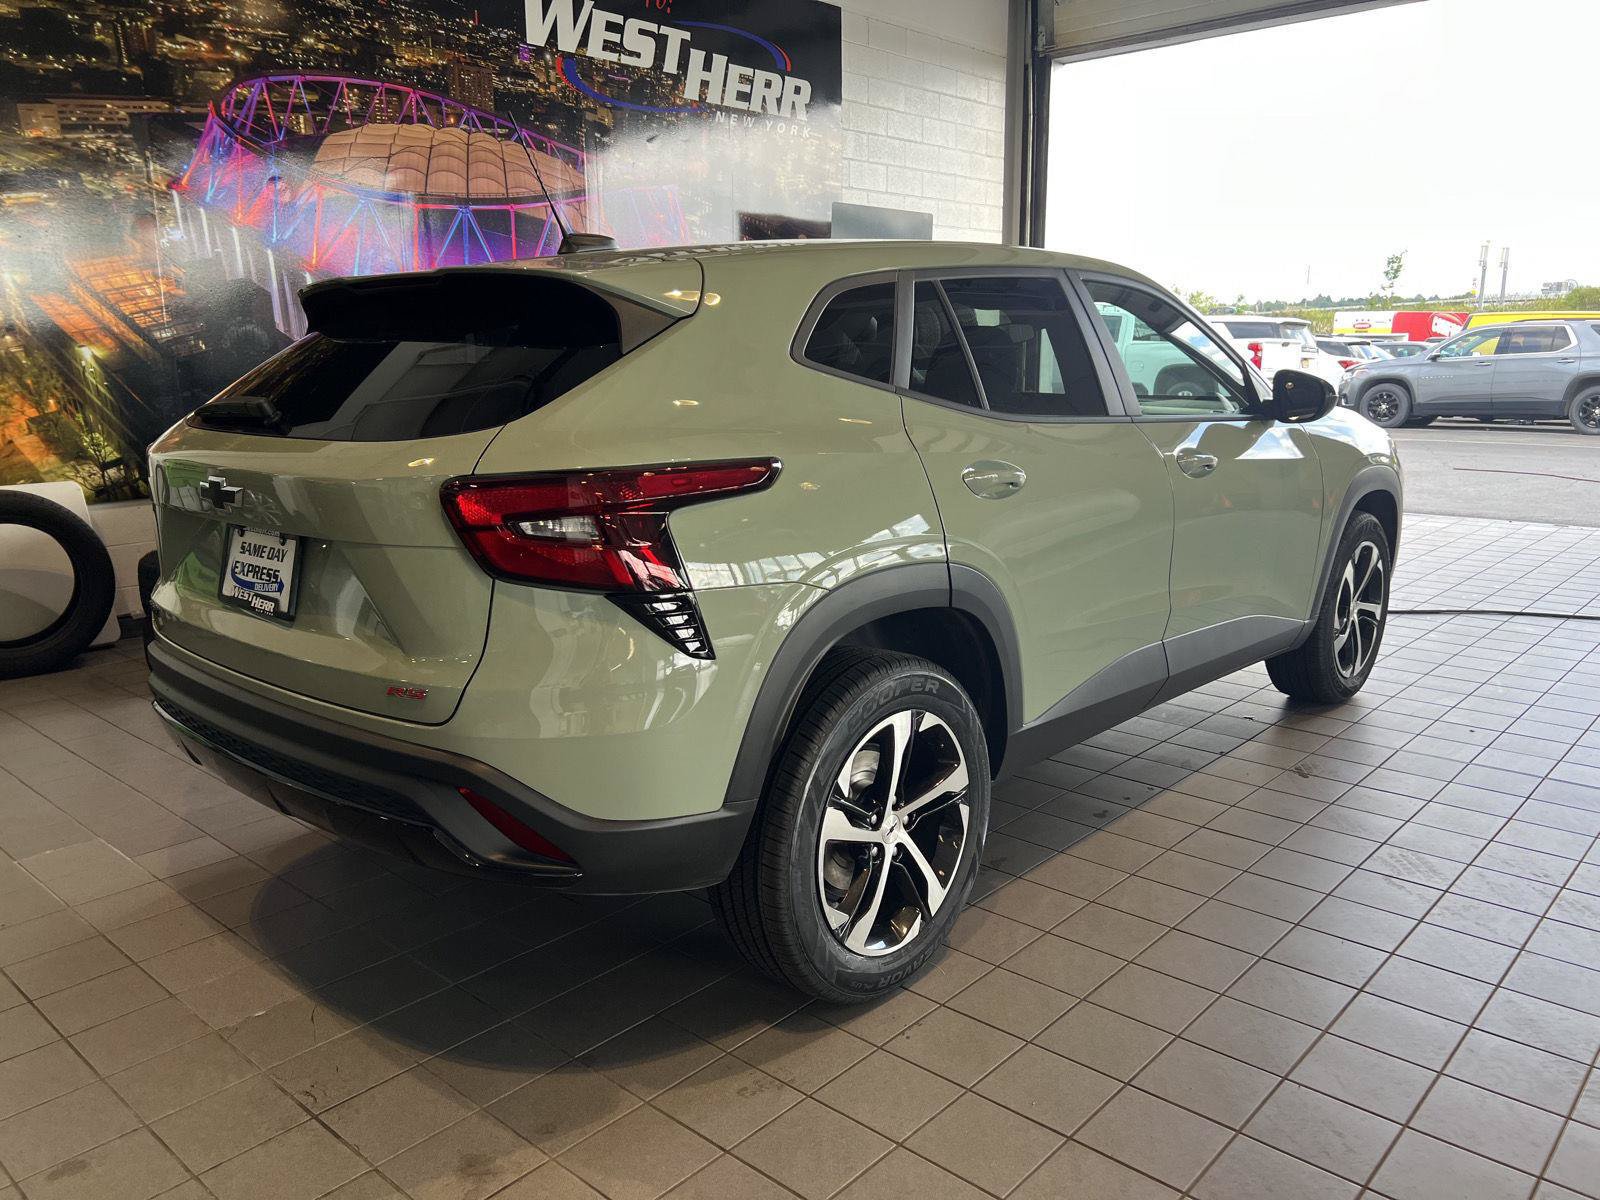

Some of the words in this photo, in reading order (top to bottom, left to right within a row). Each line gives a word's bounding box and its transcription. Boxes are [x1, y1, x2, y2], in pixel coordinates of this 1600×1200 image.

[524, 0, 691, 75] WEST
[684, 48, 812, 121] HERR
[715, 110, 757, 129] NEW
[765, 119, 812, 139] YORK
[239, 541, 268, 559] SAME
[267, 545, 289, 563] DAY
[233, 560, 281, 584] EXPRESS
[231, 585, 255, 602] WEST
[250, 595, 275, 613] HERR
[254, 582, 279, 593] DELIVERY
[385, 687, 428, 701] RS
